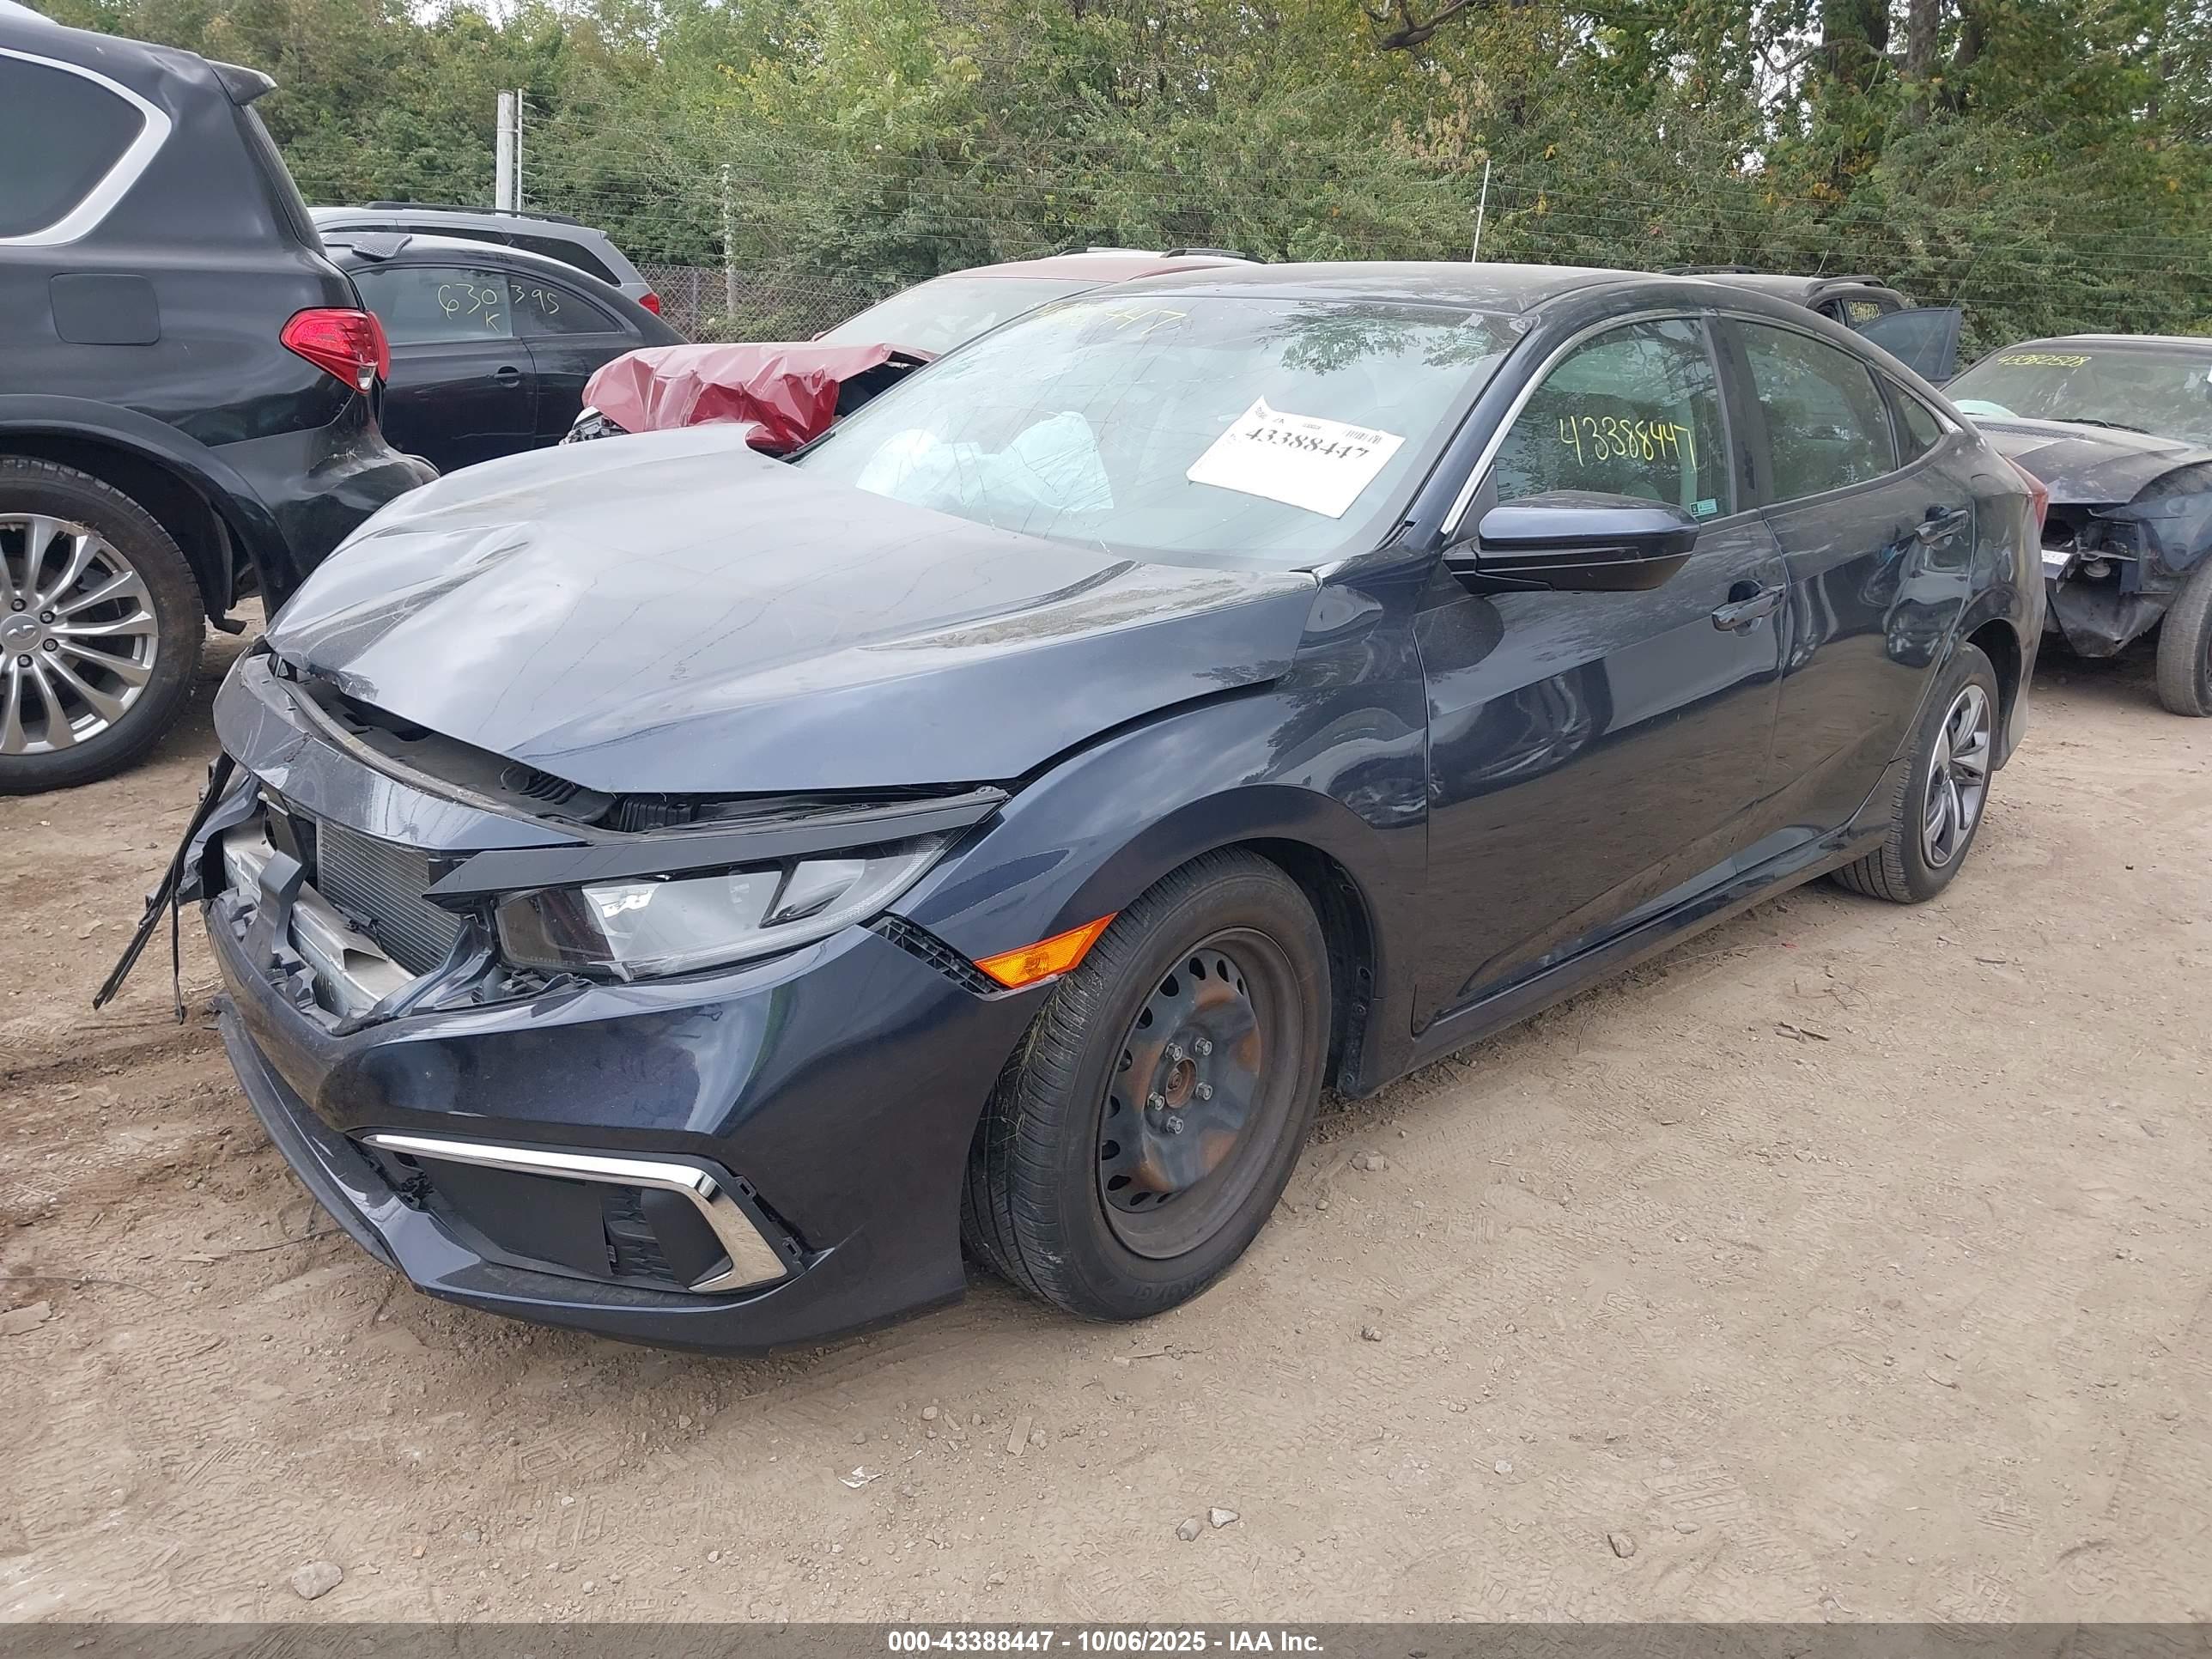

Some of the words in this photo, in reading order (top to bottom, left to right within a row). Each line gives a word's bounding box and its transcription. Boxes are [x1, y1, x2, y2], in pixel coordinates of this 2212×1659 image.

[438, 284, 497, 320] 630
[1246, 428, 1370, 459] 43388447
[1559, 416, 1697, 473] 43388447
